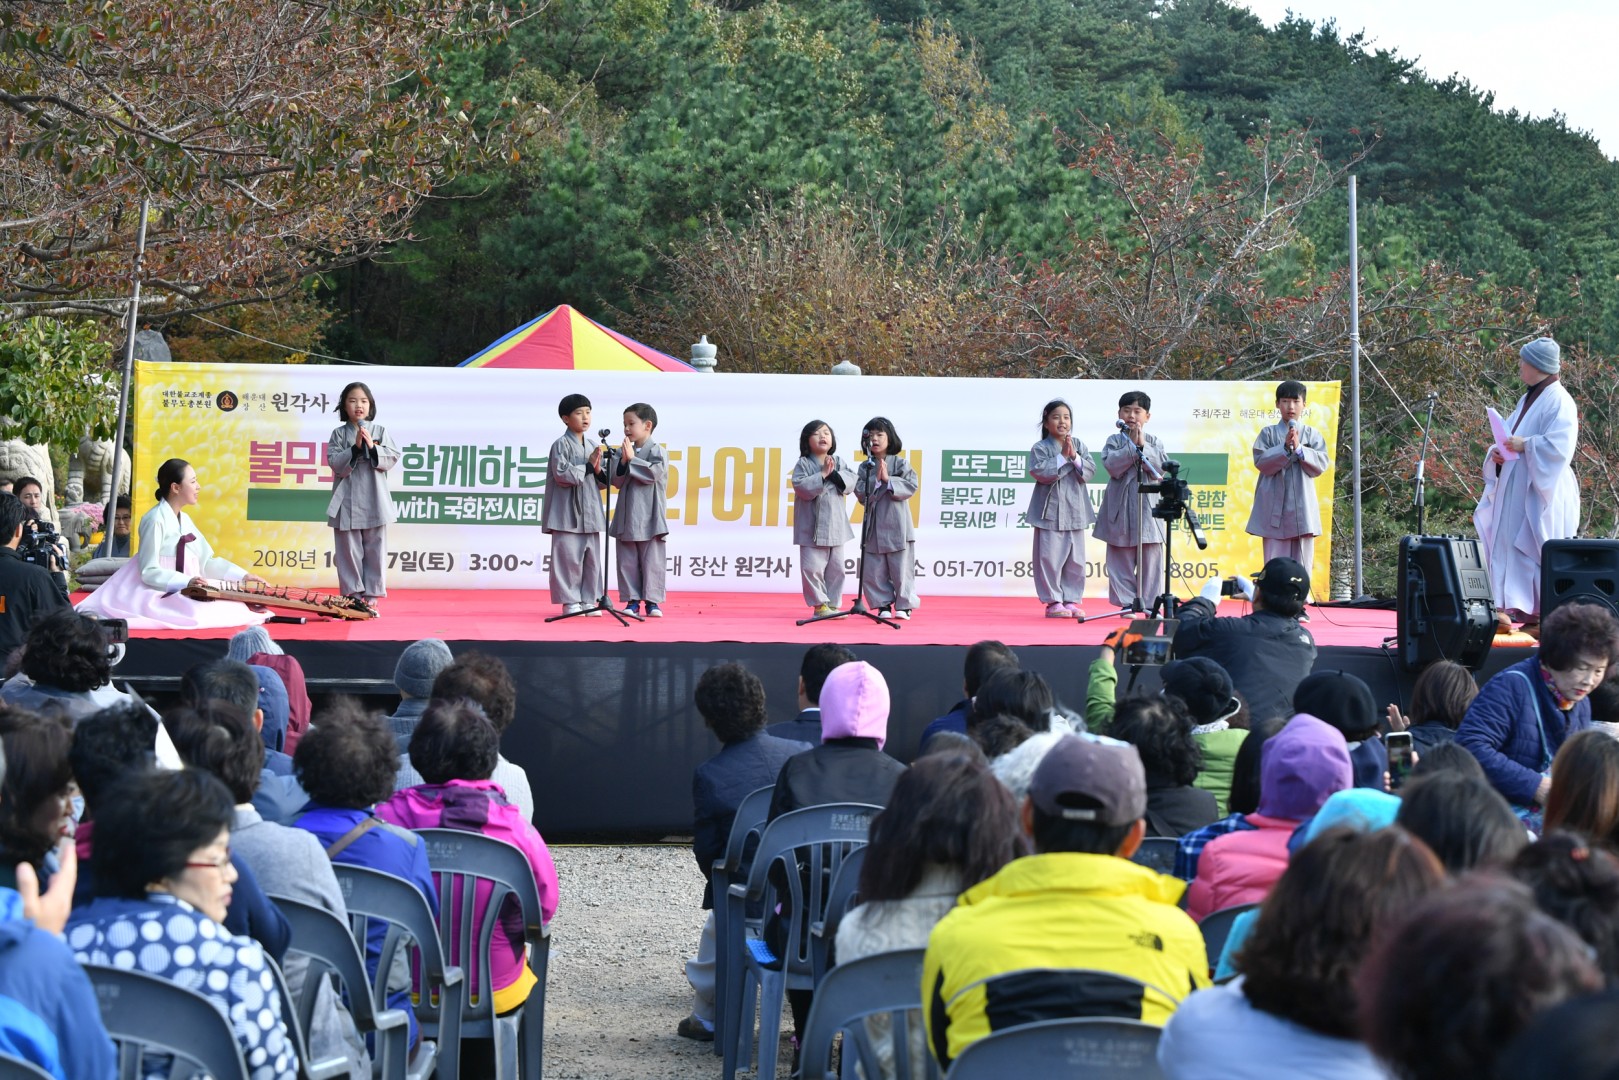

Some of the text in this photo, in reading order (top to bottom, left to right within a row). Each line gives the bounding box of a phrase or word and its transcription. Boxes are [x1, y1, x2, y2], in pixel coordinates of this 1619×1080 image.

[162, 400, 212, 408] 불무도총본원
[242, 392, 266, 401] 해운대
[271, 392, 330, 413] 원각사
[1192, 408, 1231, 418] 주최/주관
[1239, 408, 1265, 418] 해운대
[402, 443, 549, 488] 함께하는
[951, 454, 1026, 478] 프로그램
[395, 496, 542, 521] with 국화전시회
[1197, 490, 1227, 508] 합창
[939, 511, 996, 528] 무용시연
[253, 549, 316, 570] 2018년
[387, 551, 454, 572] 7일(토)
[689, 556, 728, 577] 장산
[735, 557, 792, 577] 원각사
